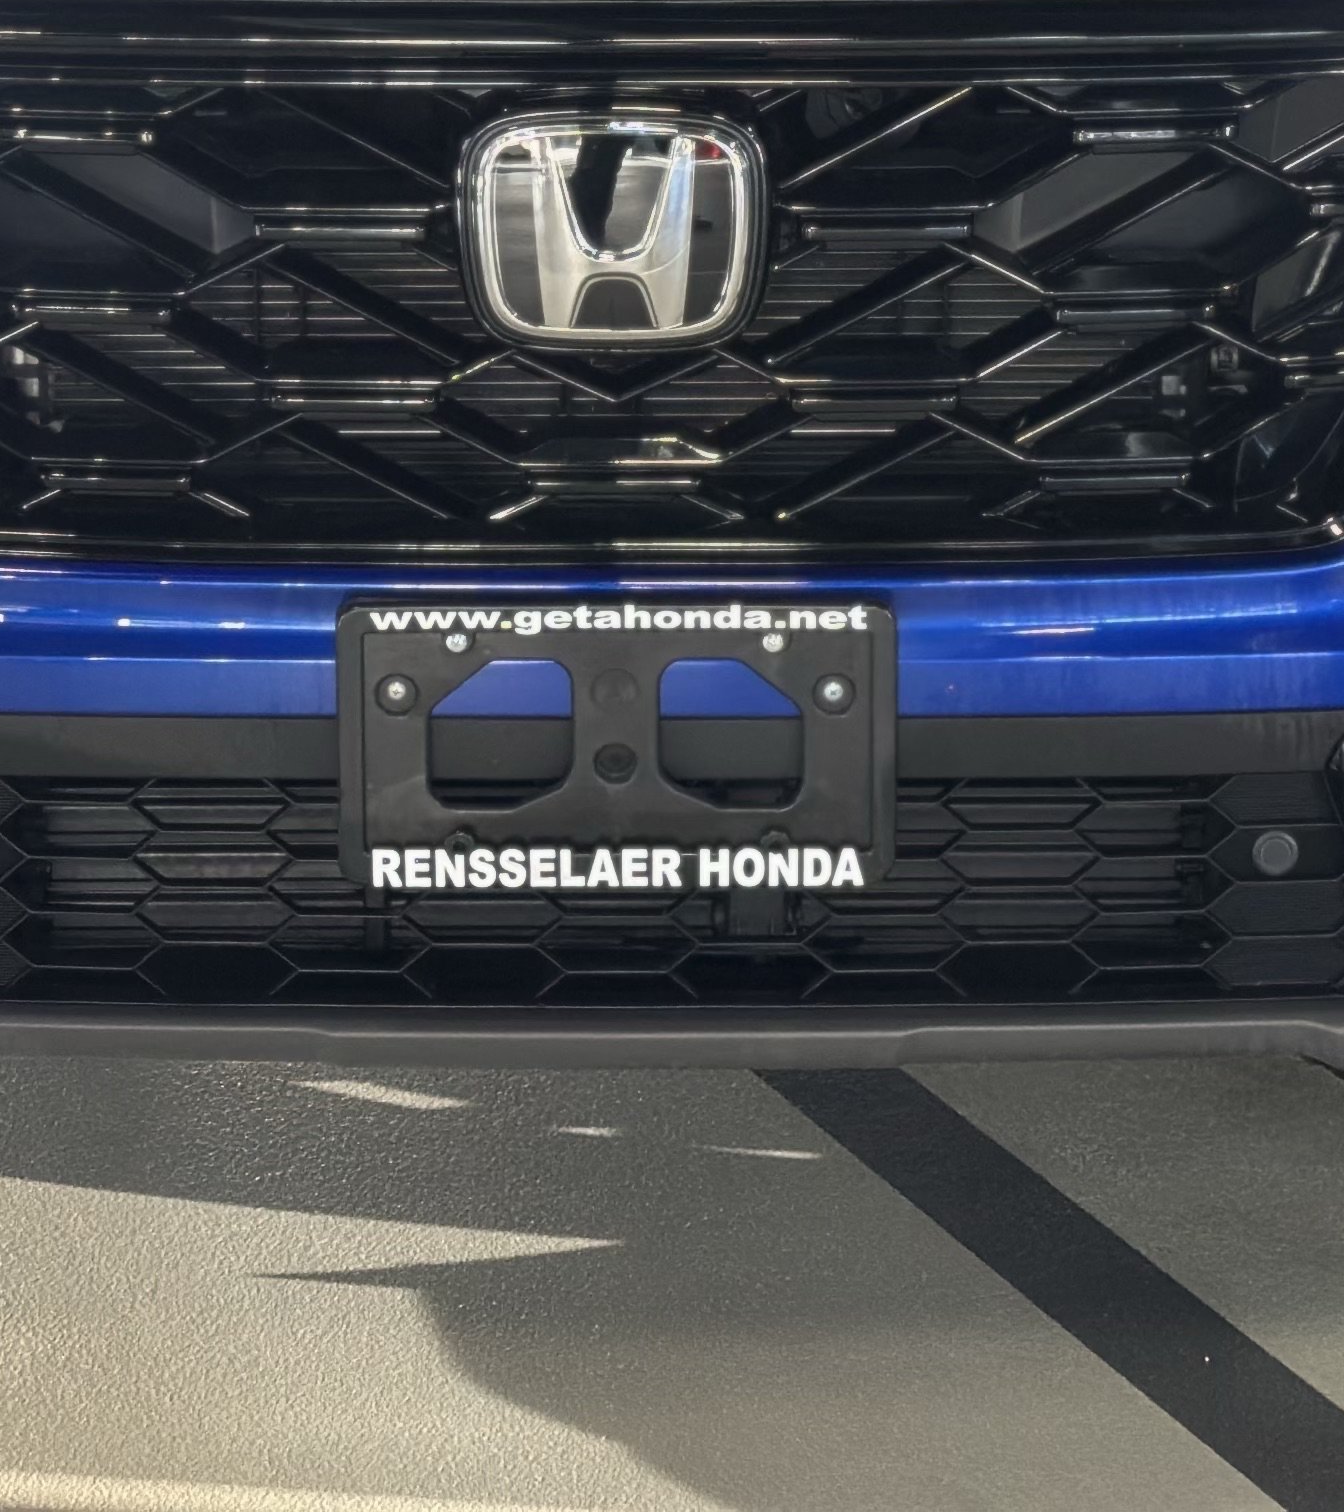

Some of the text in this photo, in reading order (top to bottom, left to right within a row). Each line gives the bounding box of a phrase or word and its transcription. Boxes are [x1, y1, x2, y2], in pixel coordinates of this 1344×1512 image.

[369, 604, 868, 635] www.getahonda.net
[371, 847, 865, 888] RENSSELAER HONDA
